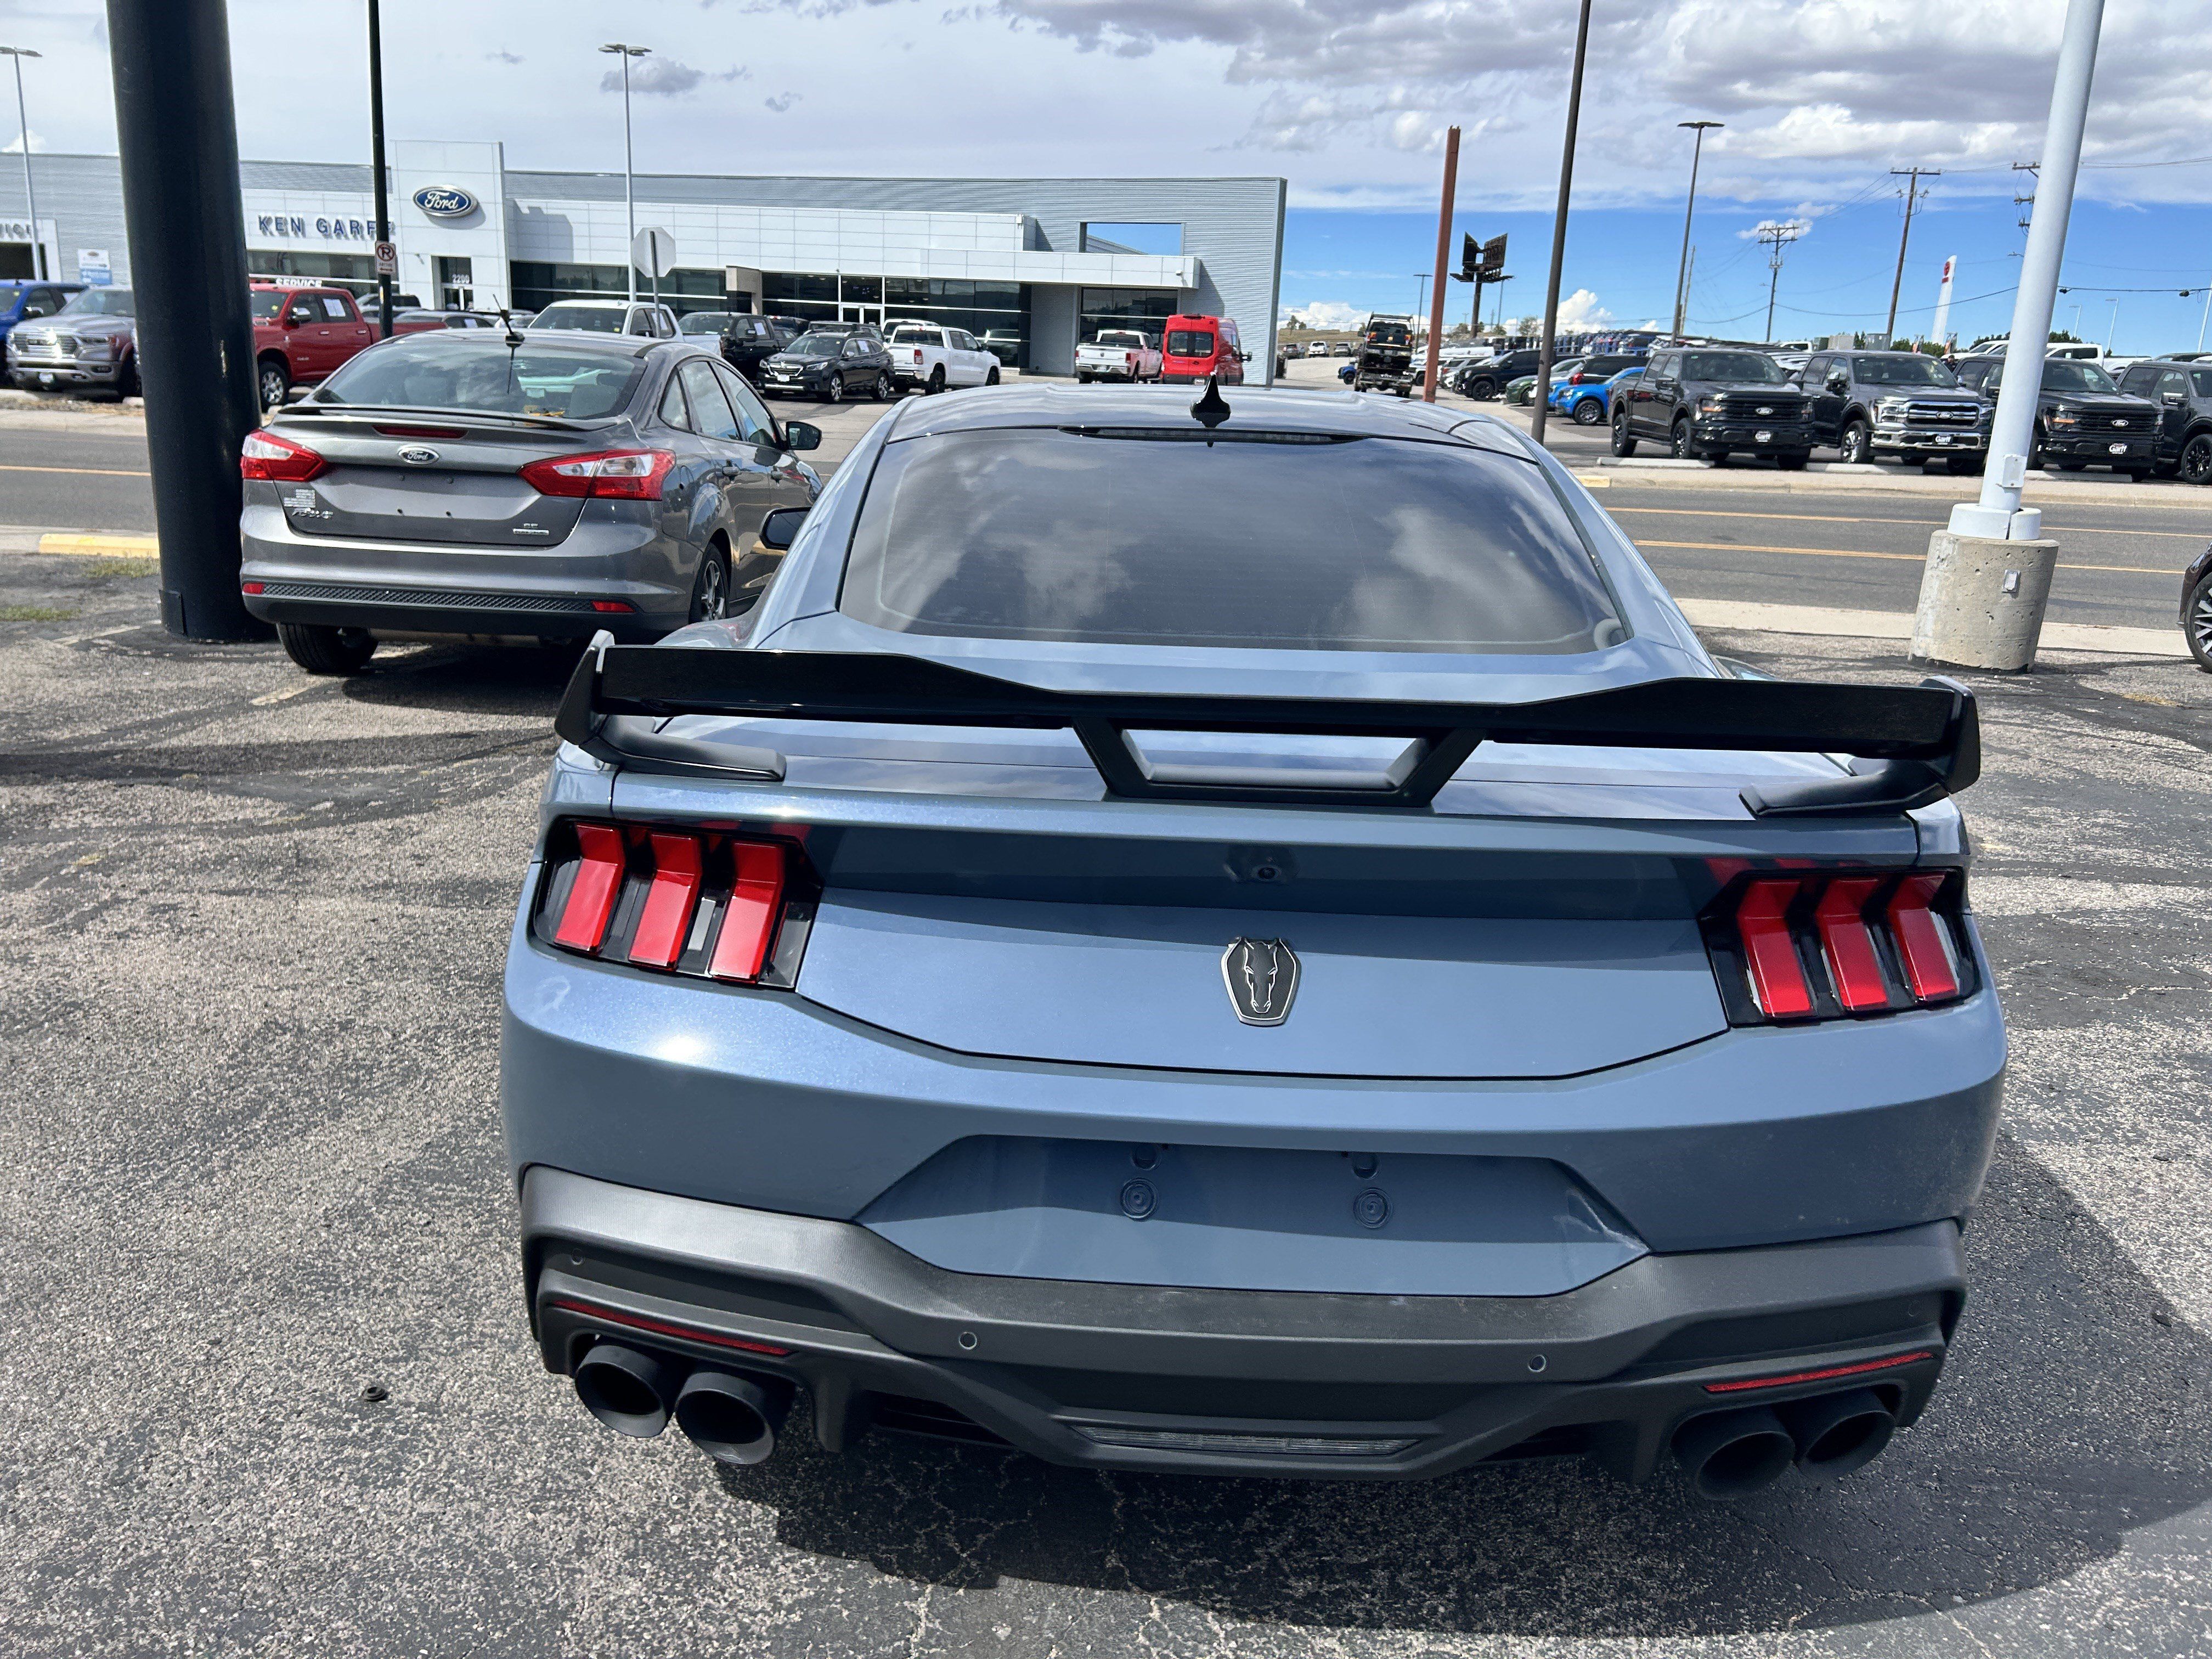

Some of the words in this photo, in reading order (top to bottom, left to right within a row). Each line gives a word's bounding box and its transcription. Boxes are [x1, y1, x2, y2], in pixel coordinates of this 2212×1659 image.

[425, 191, 460, 208] Ford
[258, 215, 302, 232] KEN
[276, 278, 323, 287] SERVICE
[407, 450, 429, 460] Ford
